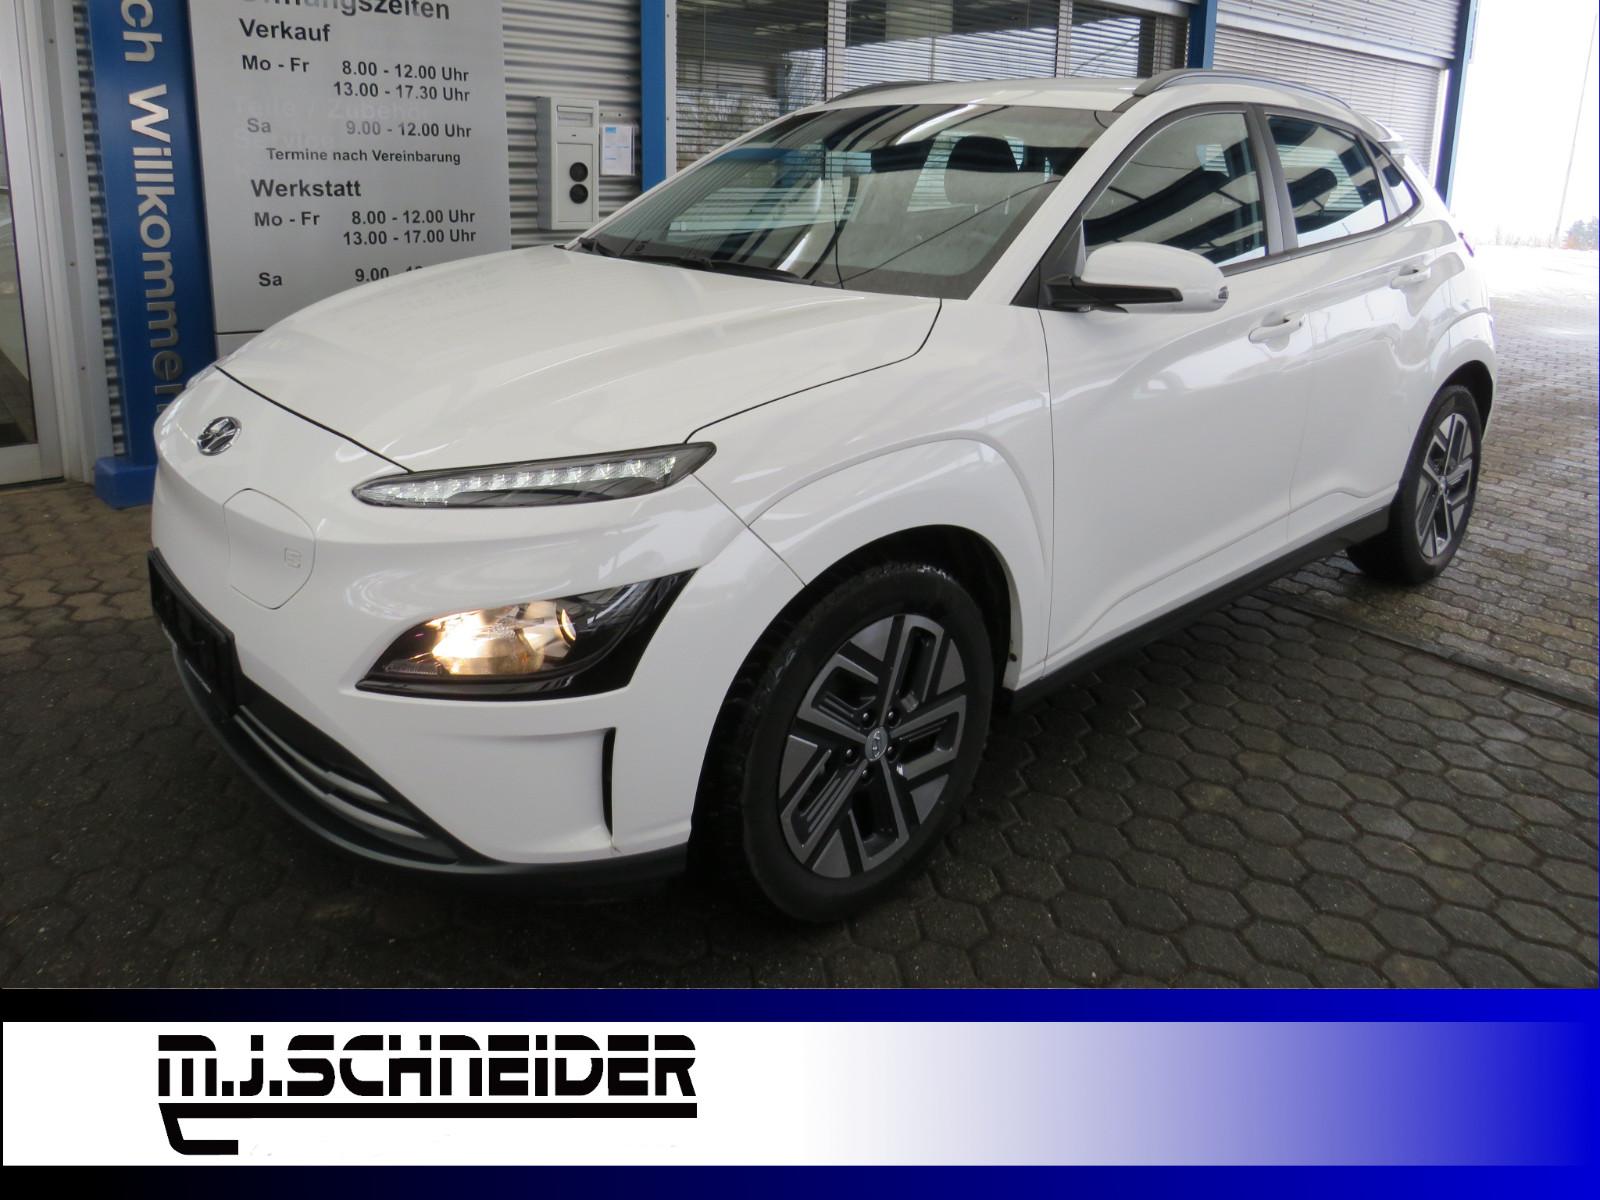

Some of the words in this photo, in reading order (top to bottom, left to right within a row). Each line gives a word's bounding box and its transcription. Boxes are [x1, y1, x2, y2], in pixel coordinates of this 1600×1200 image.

[240, 0, 450, 20] ngszeiten
[239, 18, 330, 41] Verkauf
[242, 55, 271, 70] Mo
[291, 57, 309, 72] Fr
[342, 61, 377, 76] 8.00
[395, 64, 436, 79] 12.00
[442, 67, 469, 81] Uhr
[334, 82, 378, 97] 13.00
[396, 85, 437, 99] 17.30
[443, 87, 470, 101] Uhr
[248, 118, 271, 133] Sa
[347, 121, 381, 135] 9.00
[399, 123, 439, 136] 12.00
[445, 124, 471, 137] Uhr
[267, 148, 327, 160] Termine
[333, 150, 367, 160] nach
[372, 150, 460, 165] Vereinbarung
[251, 180, 361, 197] Werkstatt
[255, 212, 282, 226] Mo
[301, 212, 320, 225] Fr
[352, 211, 385, 224] 8.00
[403, 210, 443, 223] 12.00
[449, 210, 475, 223] Uhr
[344, 231, 387, 245] 13.00
[404, 229, 444, 243] 17.00
[450, 229, 476, 242] Uhr
[259, 272, 282, 286] Sa
[355, 267, 389, 282] 9.00
